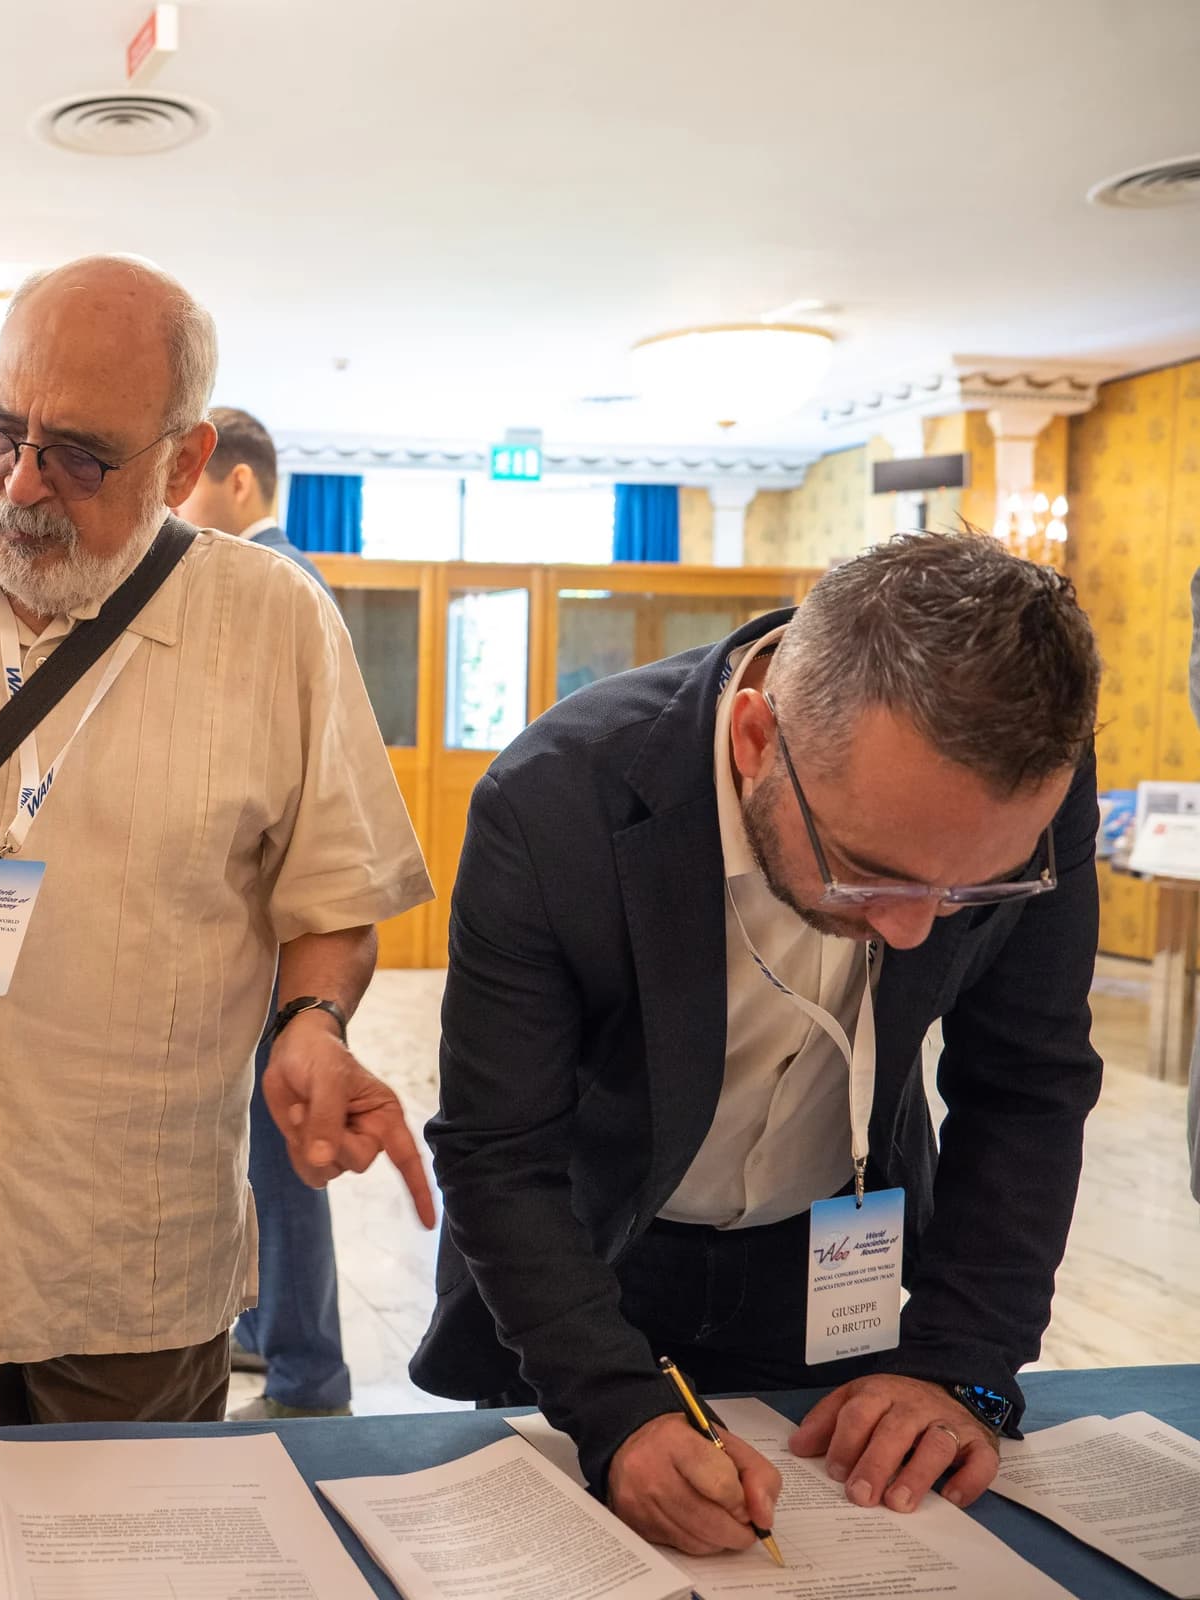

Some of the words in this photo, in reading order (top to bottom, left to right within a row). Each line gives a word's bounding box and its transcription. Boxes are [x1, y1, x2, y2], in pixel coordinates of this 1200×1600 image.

[27, 768, 54, 819] WAN
[831, 1300, 877, 1318] GIUSEPPE
[826, 1325, 840, 1337] LO
[842, 1317, 881, 1334] BRUTTO
